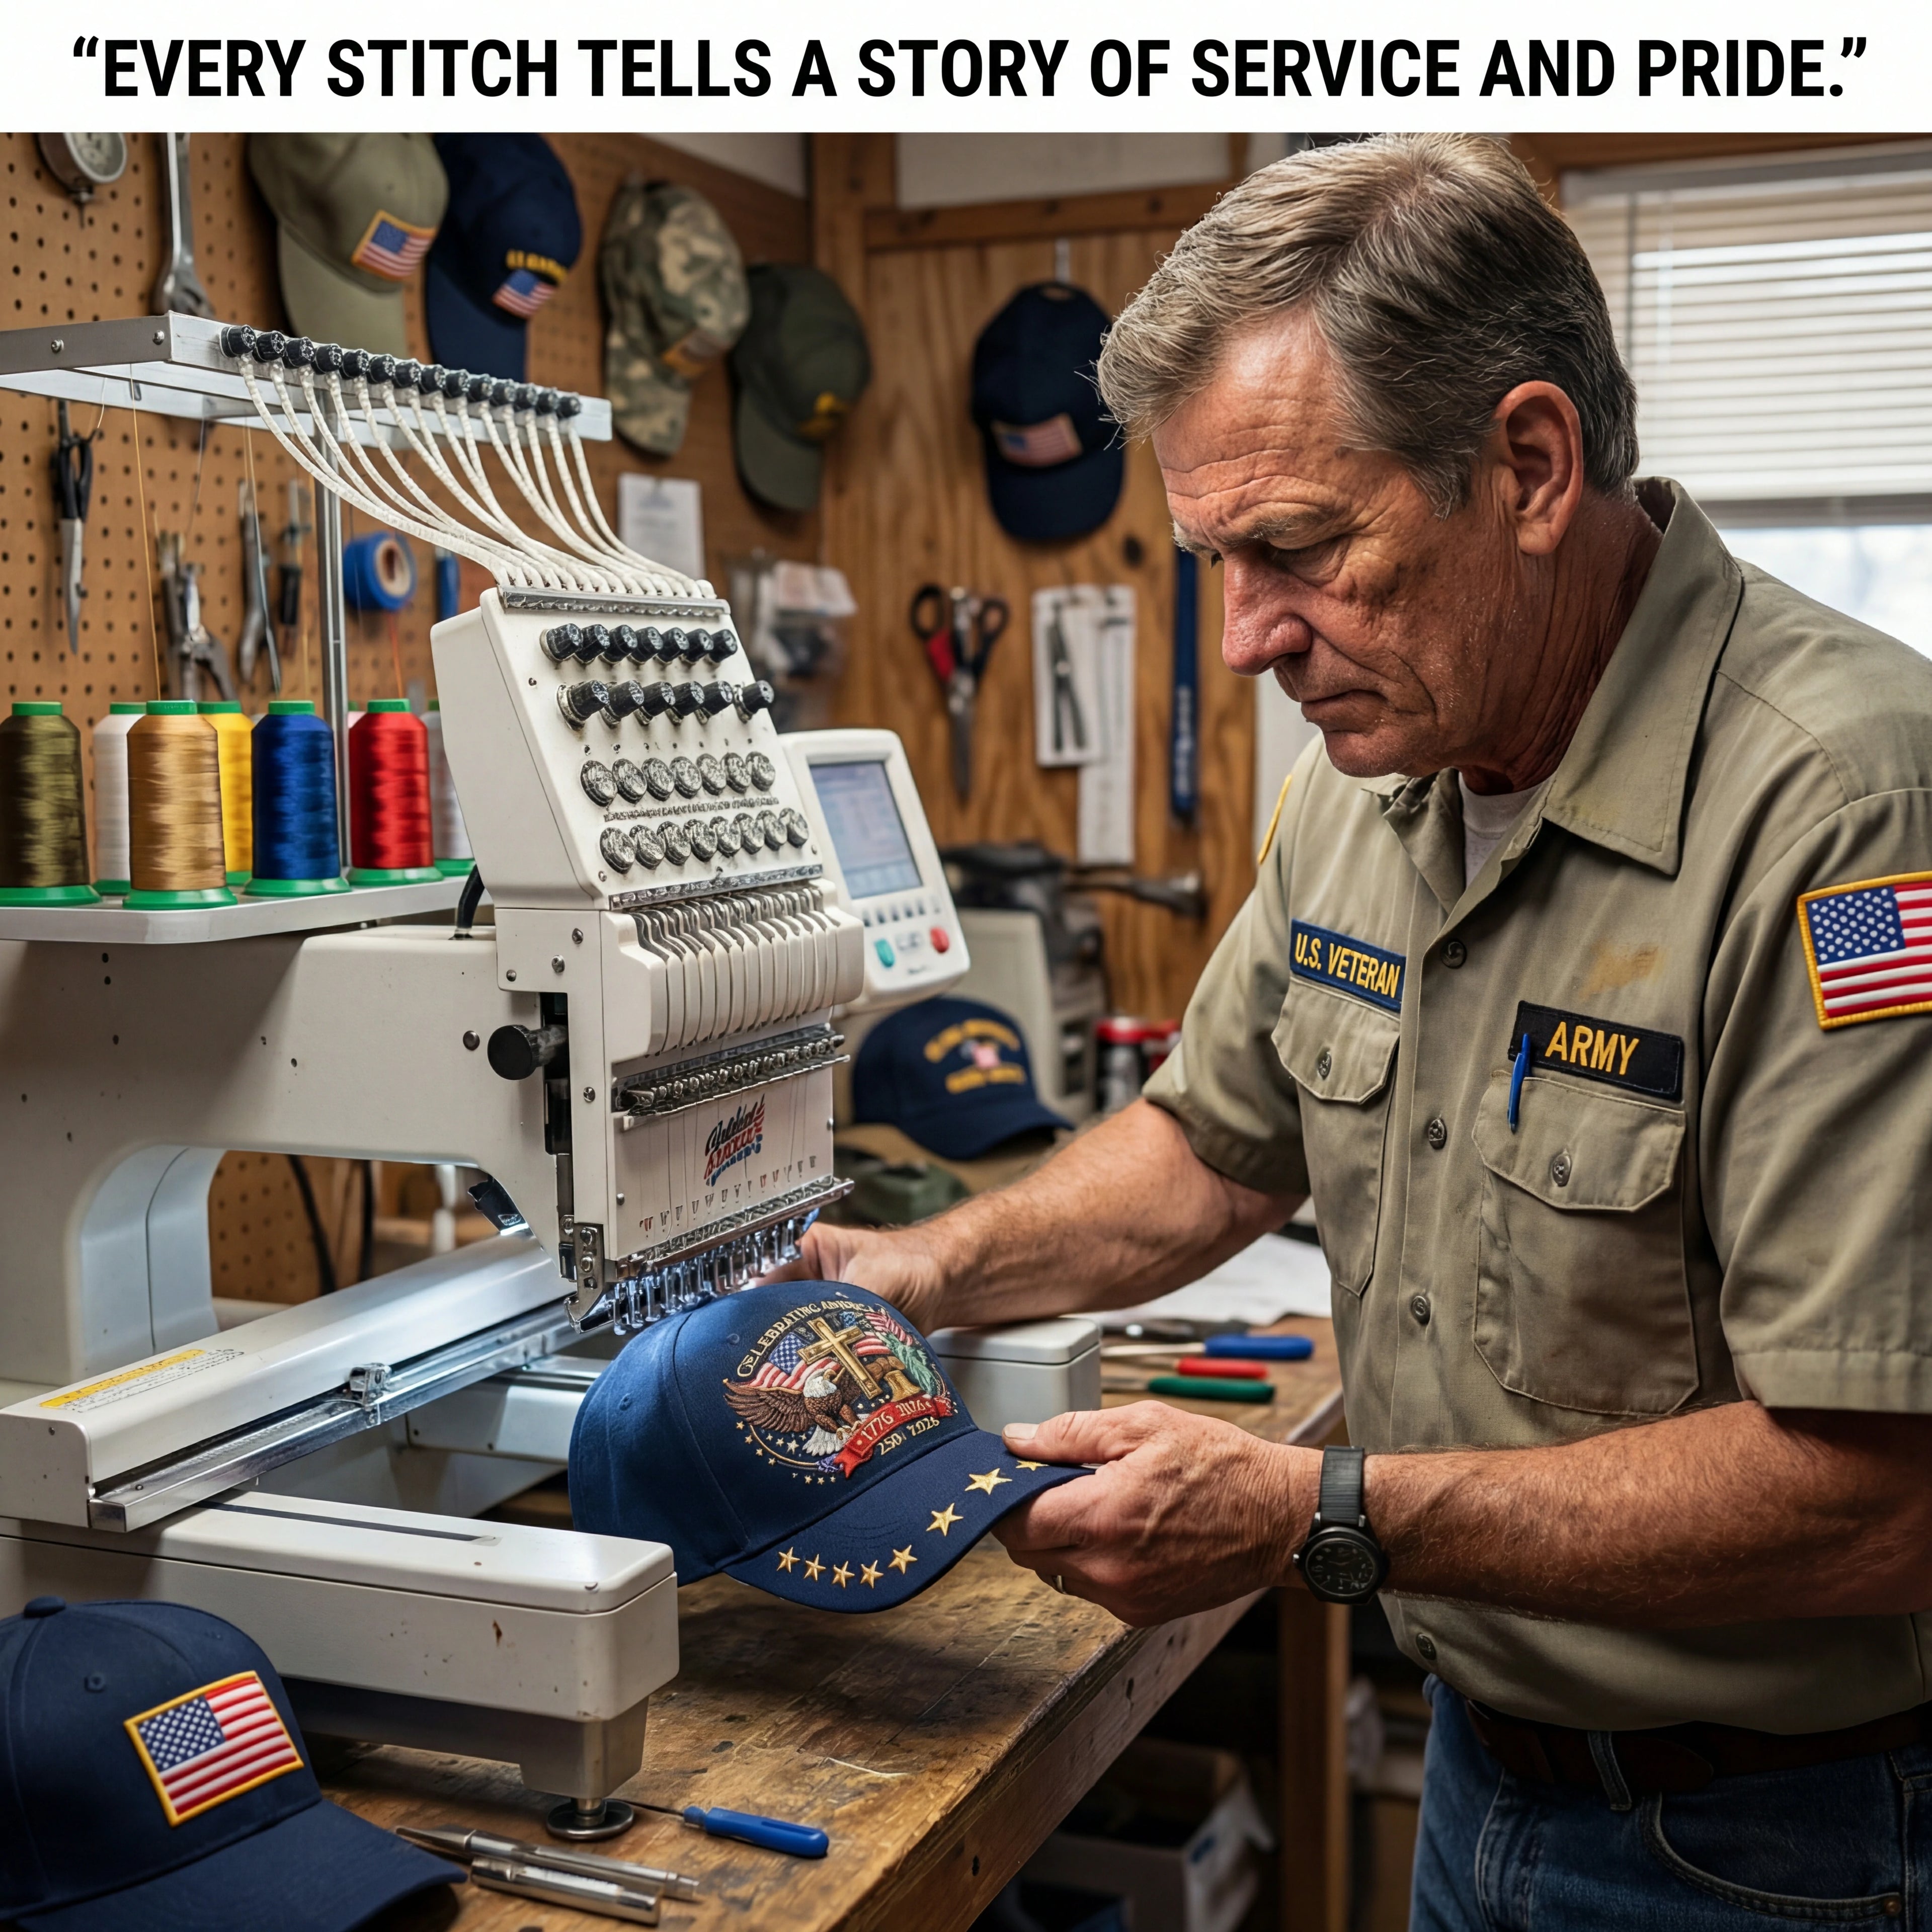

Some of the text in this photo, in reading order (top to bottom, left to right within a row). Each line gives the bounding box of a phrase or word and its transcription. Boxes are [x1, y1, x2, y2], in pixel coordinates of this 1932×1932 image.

[1295, 933, 1400, 998] U.S. VETERAN
[1545, 1021, 1639, 1075] ARMY
[860, 1411, 895, 1440] 1776
